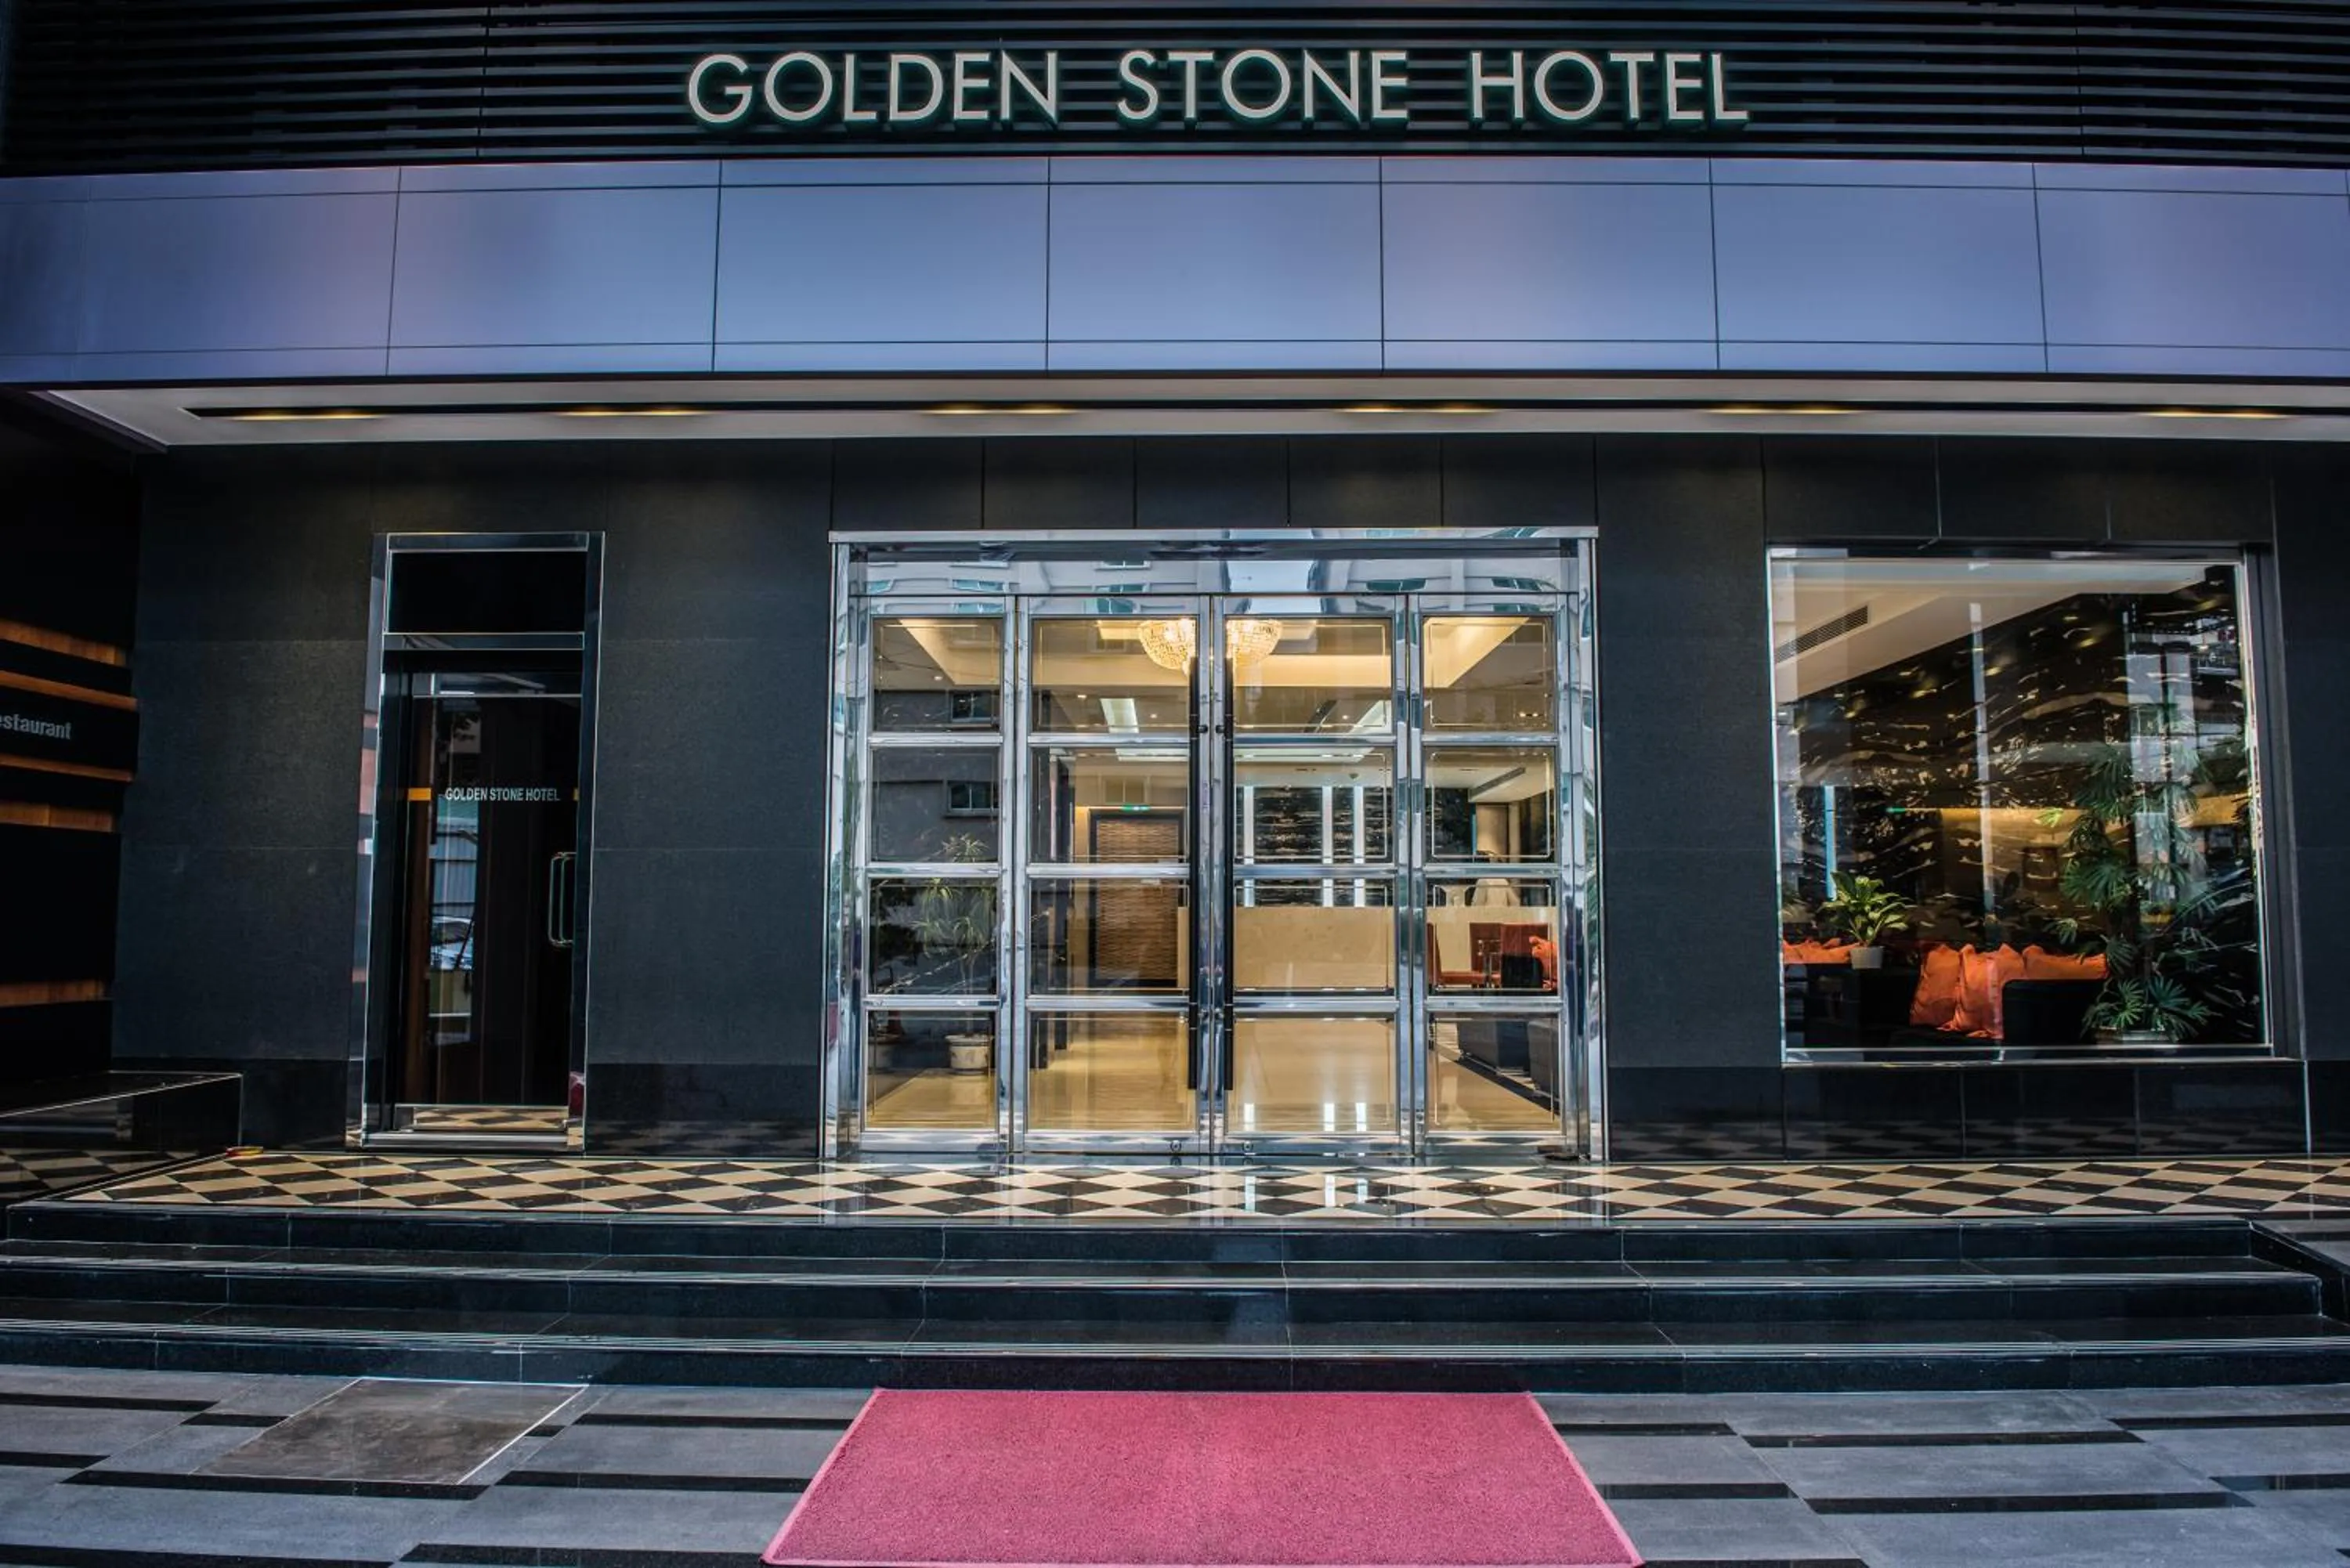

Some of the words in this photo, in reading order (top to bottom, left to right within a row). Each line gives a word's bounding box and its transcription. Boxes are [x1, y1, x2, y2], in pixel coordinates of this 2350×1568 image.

[689, 51, 1058, 124] GOLDEN
[1116, 49, 1408, 121] STONE
[1471, 51, 1749, 121] HOTEL
[445, 786, 488, 801] GOLDEN
[489, 787, 524, 801] STONE
[526, 787, 561, 801] HOTEL
